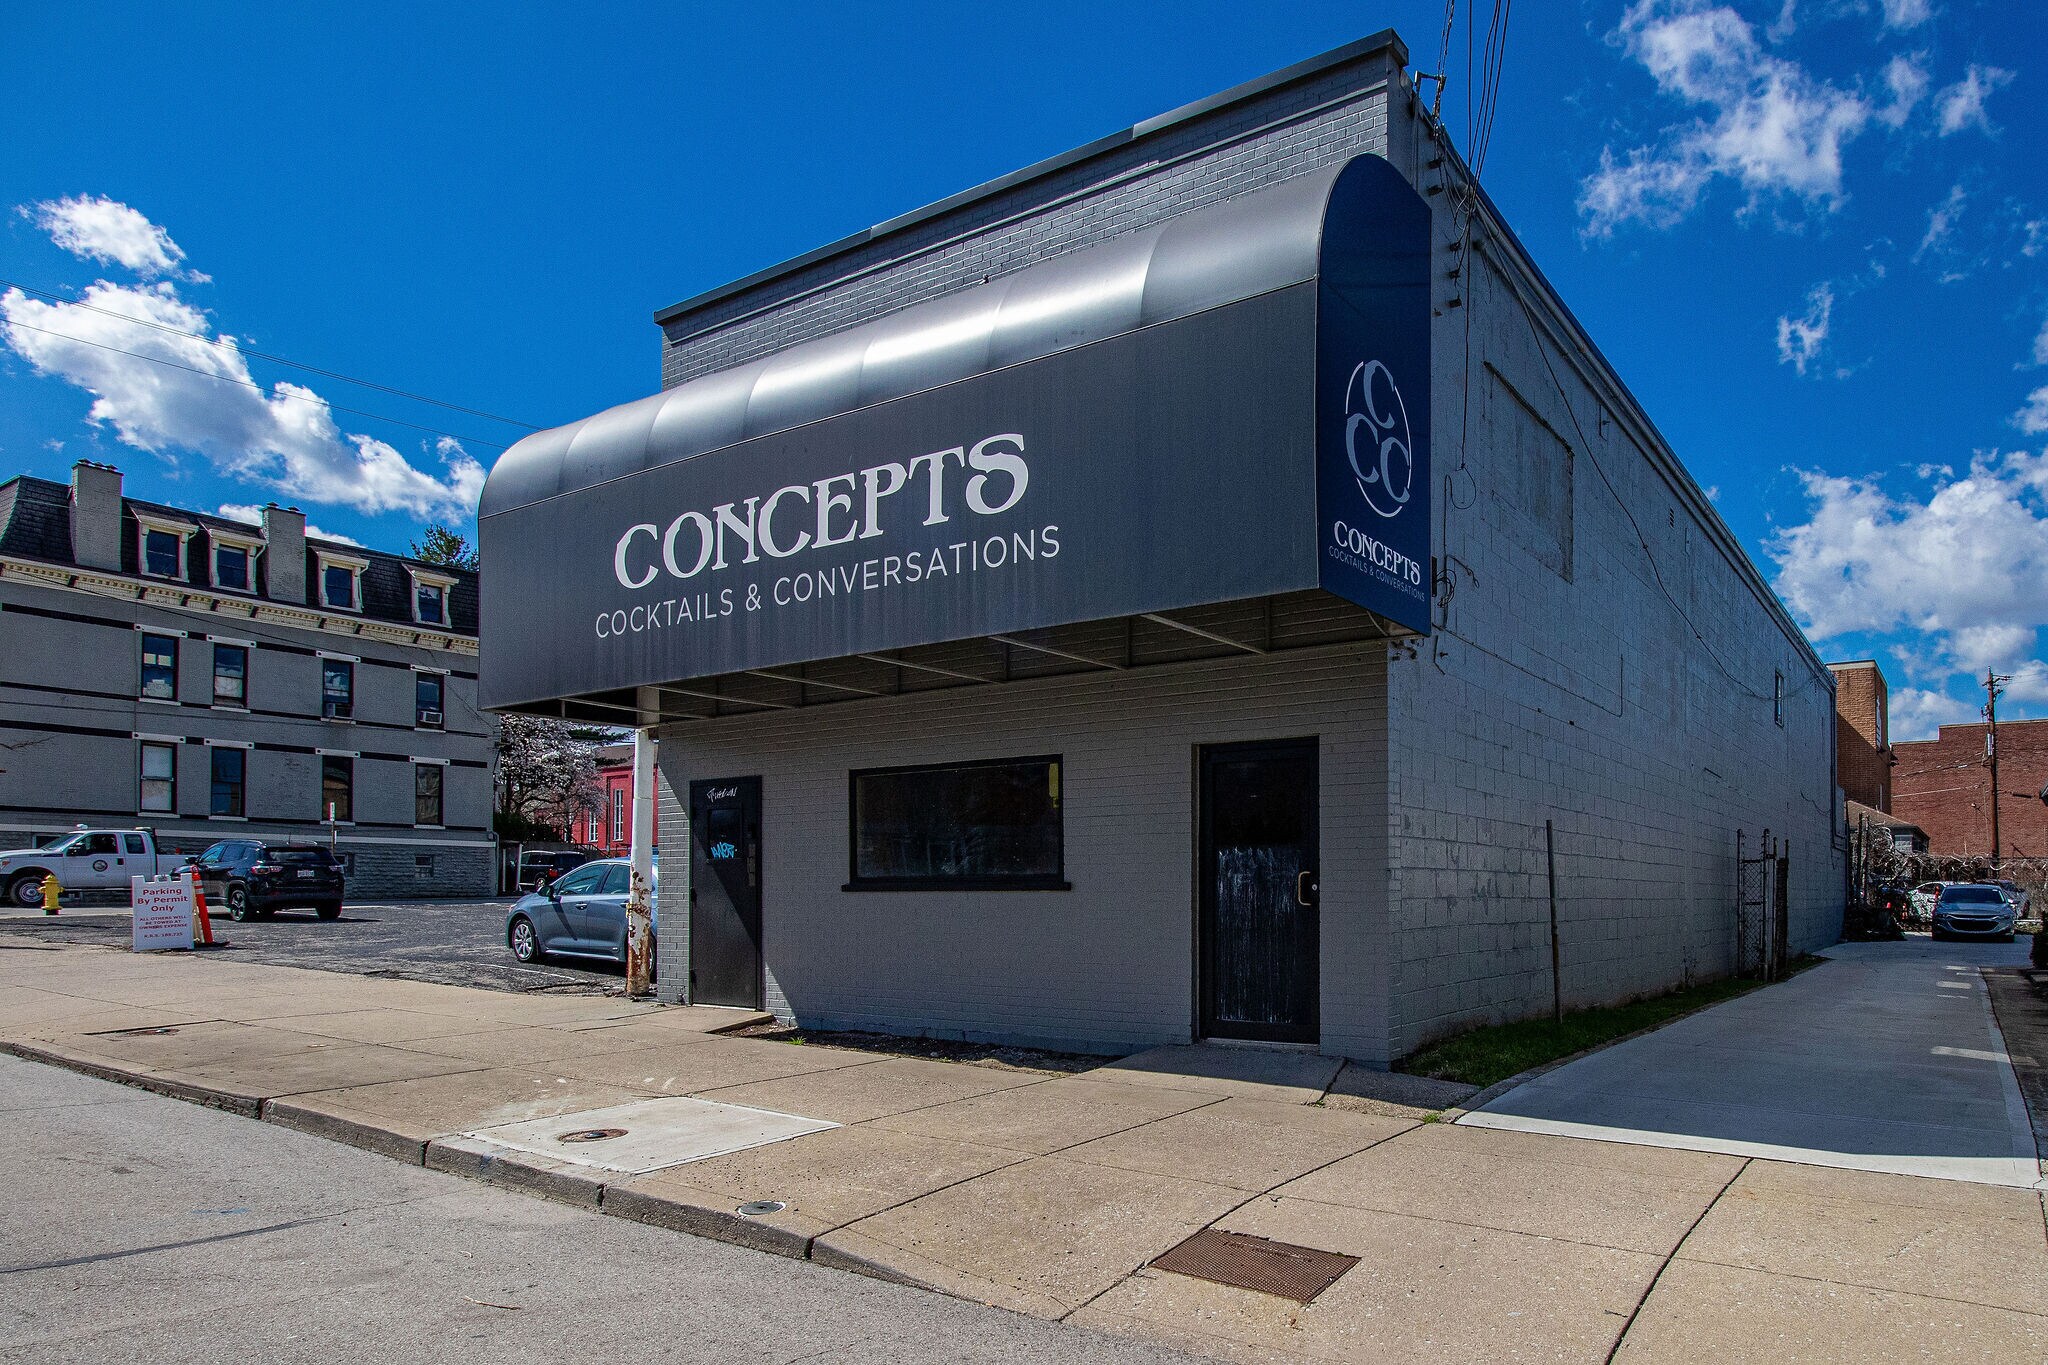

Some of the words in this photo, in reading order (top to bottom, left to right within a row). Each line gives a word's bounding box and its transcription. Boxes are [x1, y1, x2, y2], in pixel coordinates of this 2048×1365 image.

[614, 433, 1030, 589] CONCEPTS
[595, 588, 735, 639] COCKTAILS
[745, 583, 762, 612] &
[773, 525, 1062, 608] CONVERSATIONS
[1328, 545, 1368, 574] COCKTAILS
[1369, 565, 1375, 577] &
[1375, 569, 1426, 602] CONVERSATIONS
[1334, 520, 1421, 585] CONCEPTS
[137, 897, 150, 905] By
[153, 896, 189, 904] Permit
